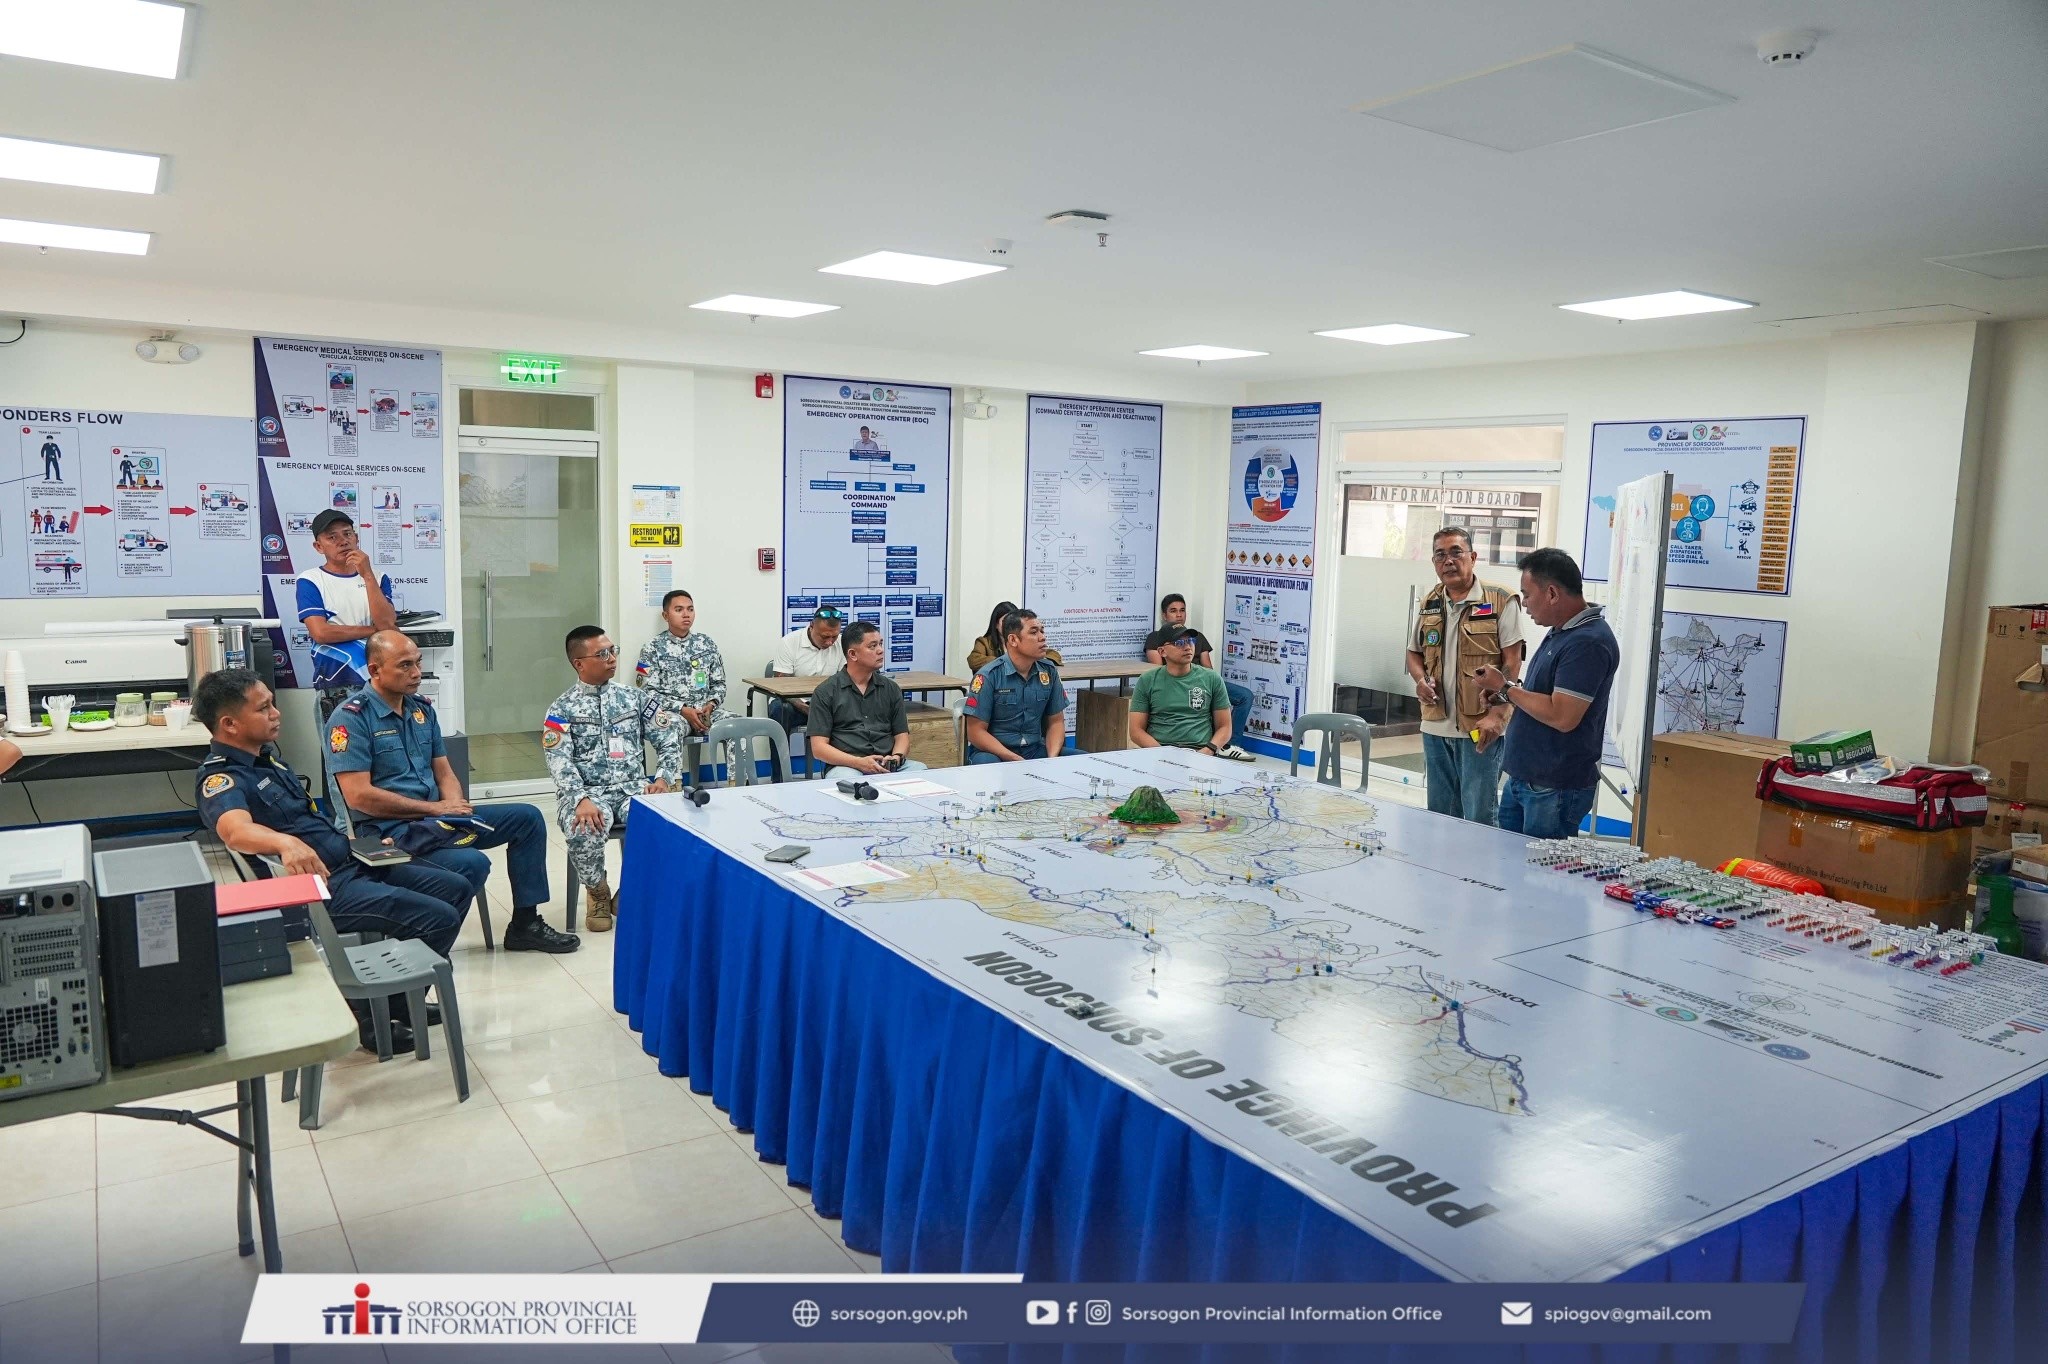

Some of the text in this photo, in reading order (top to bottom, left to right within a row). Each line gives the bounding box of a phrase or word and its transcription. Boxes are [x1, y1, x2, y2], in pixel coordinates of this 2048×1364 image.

[273, 343, 424, 361] EMERGENCY MEDICAL SERVICES ON-SCENE
[507, 358, 561, 384] EXIT
[0, 409, 123, 424] ONDERS FLOW
[848, 412, 885, 420] OPERATION
[887, 415, 911, 423] CENTER
[277, 462, 322, 470] EMERGENCY
[356, 464, 389, 472] SERVICES
[1477, 491, 1520, 506] BOARD
[632, 528, 662, 536] RESTROOM
[1227, 574, 1262, 586] COMMUNICATION
[1267, 578, 1295, 590] INFORMATION
[1296, 580, 1308, 591] FLOW
[1845, 744, 1873, 760] REGULATOR
[1875, 883, 1887, 893] Ltd
[1330, 902, 1425, 935] MAGALLANES
[1001, 931, 1058, 958] CASTILLA
[1394, 940, 1443, 958] PILAR
[1466, 979, 1539, 1009] DONSOL
[1811, 1034, 1876, 1057] PROVINCIAL
[1958, 1033, 2026, 1057] LEGEND:
[1877, 1057, 1944, 1080] SORSOGON
[963, 950, 1500, 1229] PROVINCE OF SORSOGON
